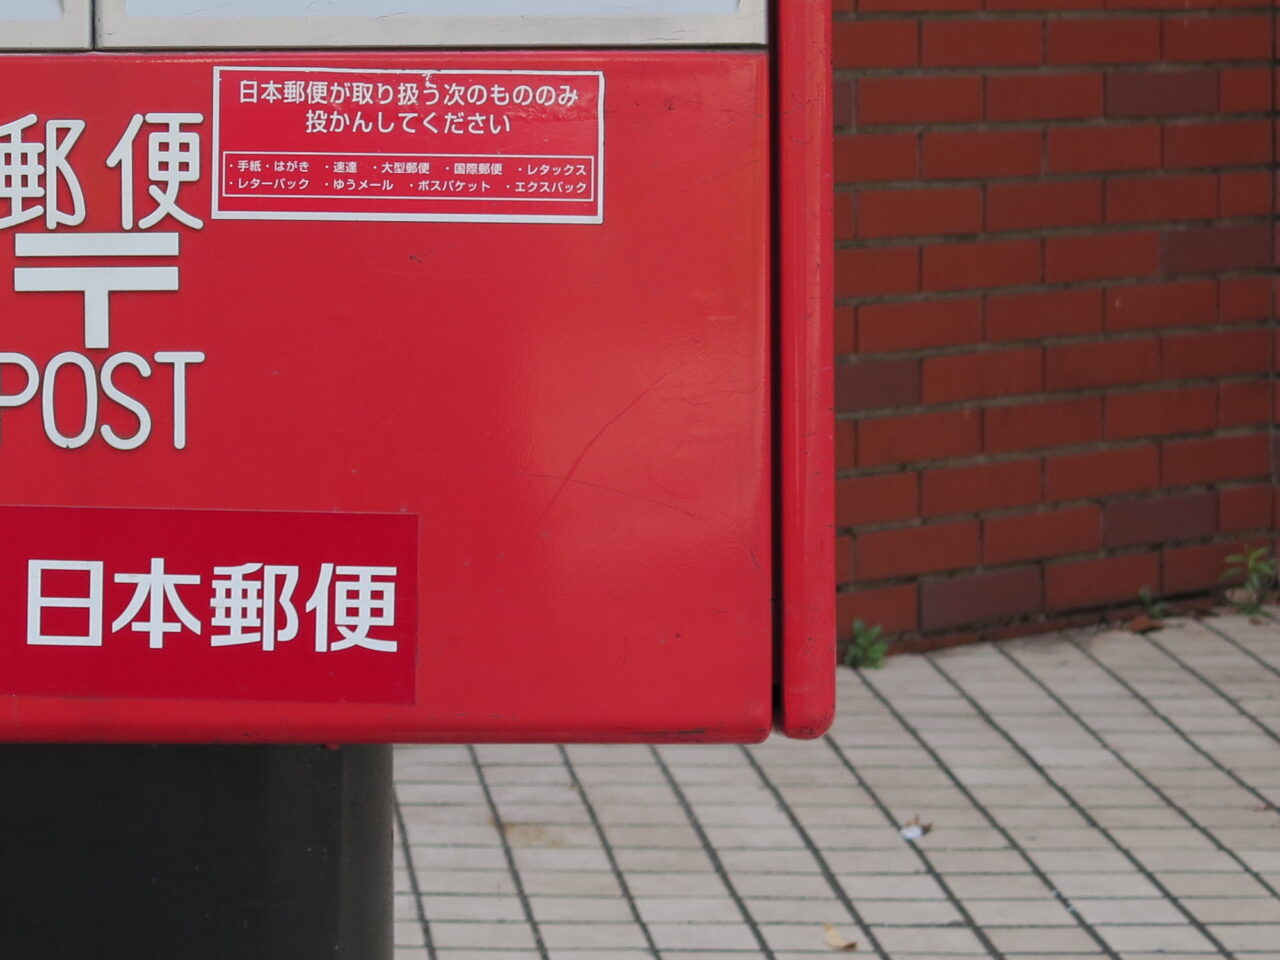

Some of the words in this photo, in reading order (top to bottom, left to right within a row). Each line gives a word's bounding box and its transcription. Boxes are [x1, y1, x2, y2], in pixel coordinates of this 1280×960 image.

[239, 79, 579, 107] 日本郵便が取り扱う次のもののみ
[306, 109, 511, 135] 投かんしてください
[25, 556, 399, 653] 日本郵便
